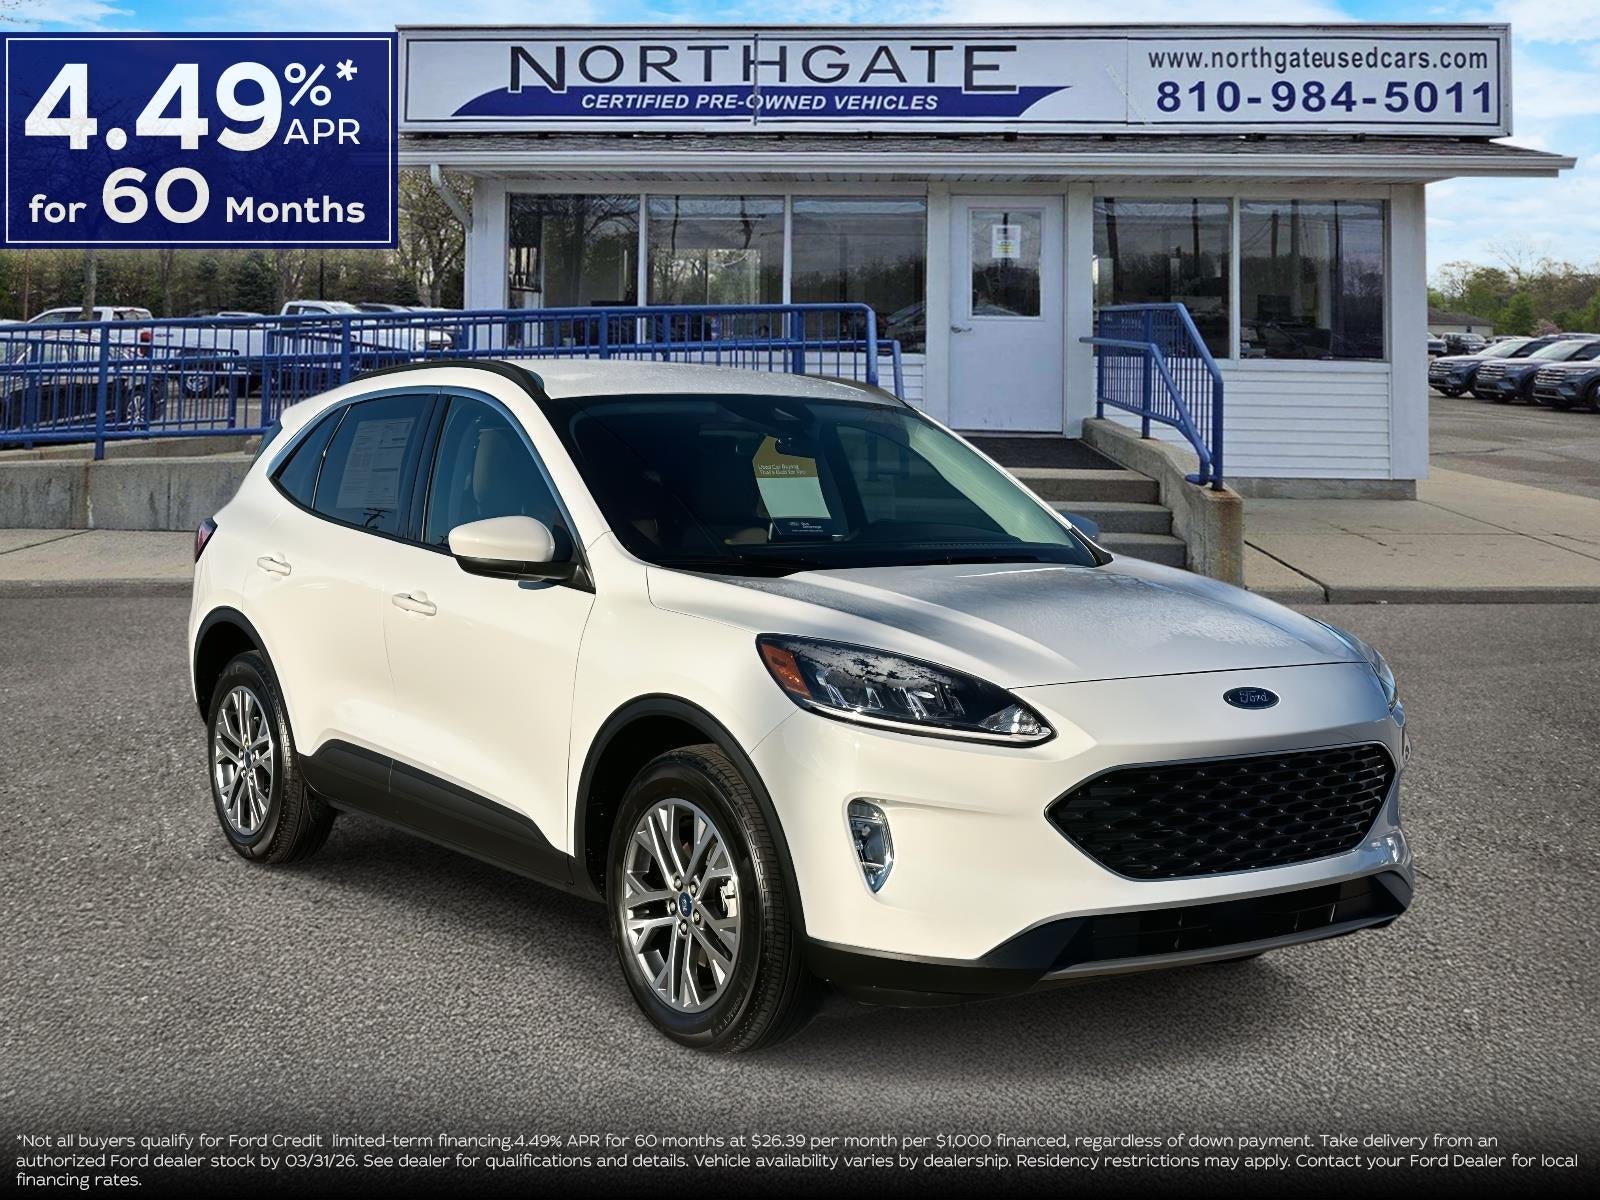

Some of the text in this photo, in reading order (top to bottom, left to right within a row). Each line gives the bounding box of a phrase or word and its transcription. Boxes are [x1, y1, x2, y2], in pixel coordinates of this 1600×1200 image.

[510, 45, 1017, 92] NORTHGATE
[1149, 46, 1488, 73] www.northgateusedcars.com
[581, 94, 938, 110] CERTIFIED PRE-OWNED VEHICLES
[1156, 80, 1491, 114] 810-984-5011
[1239, 690, 1269, 703] Ford
